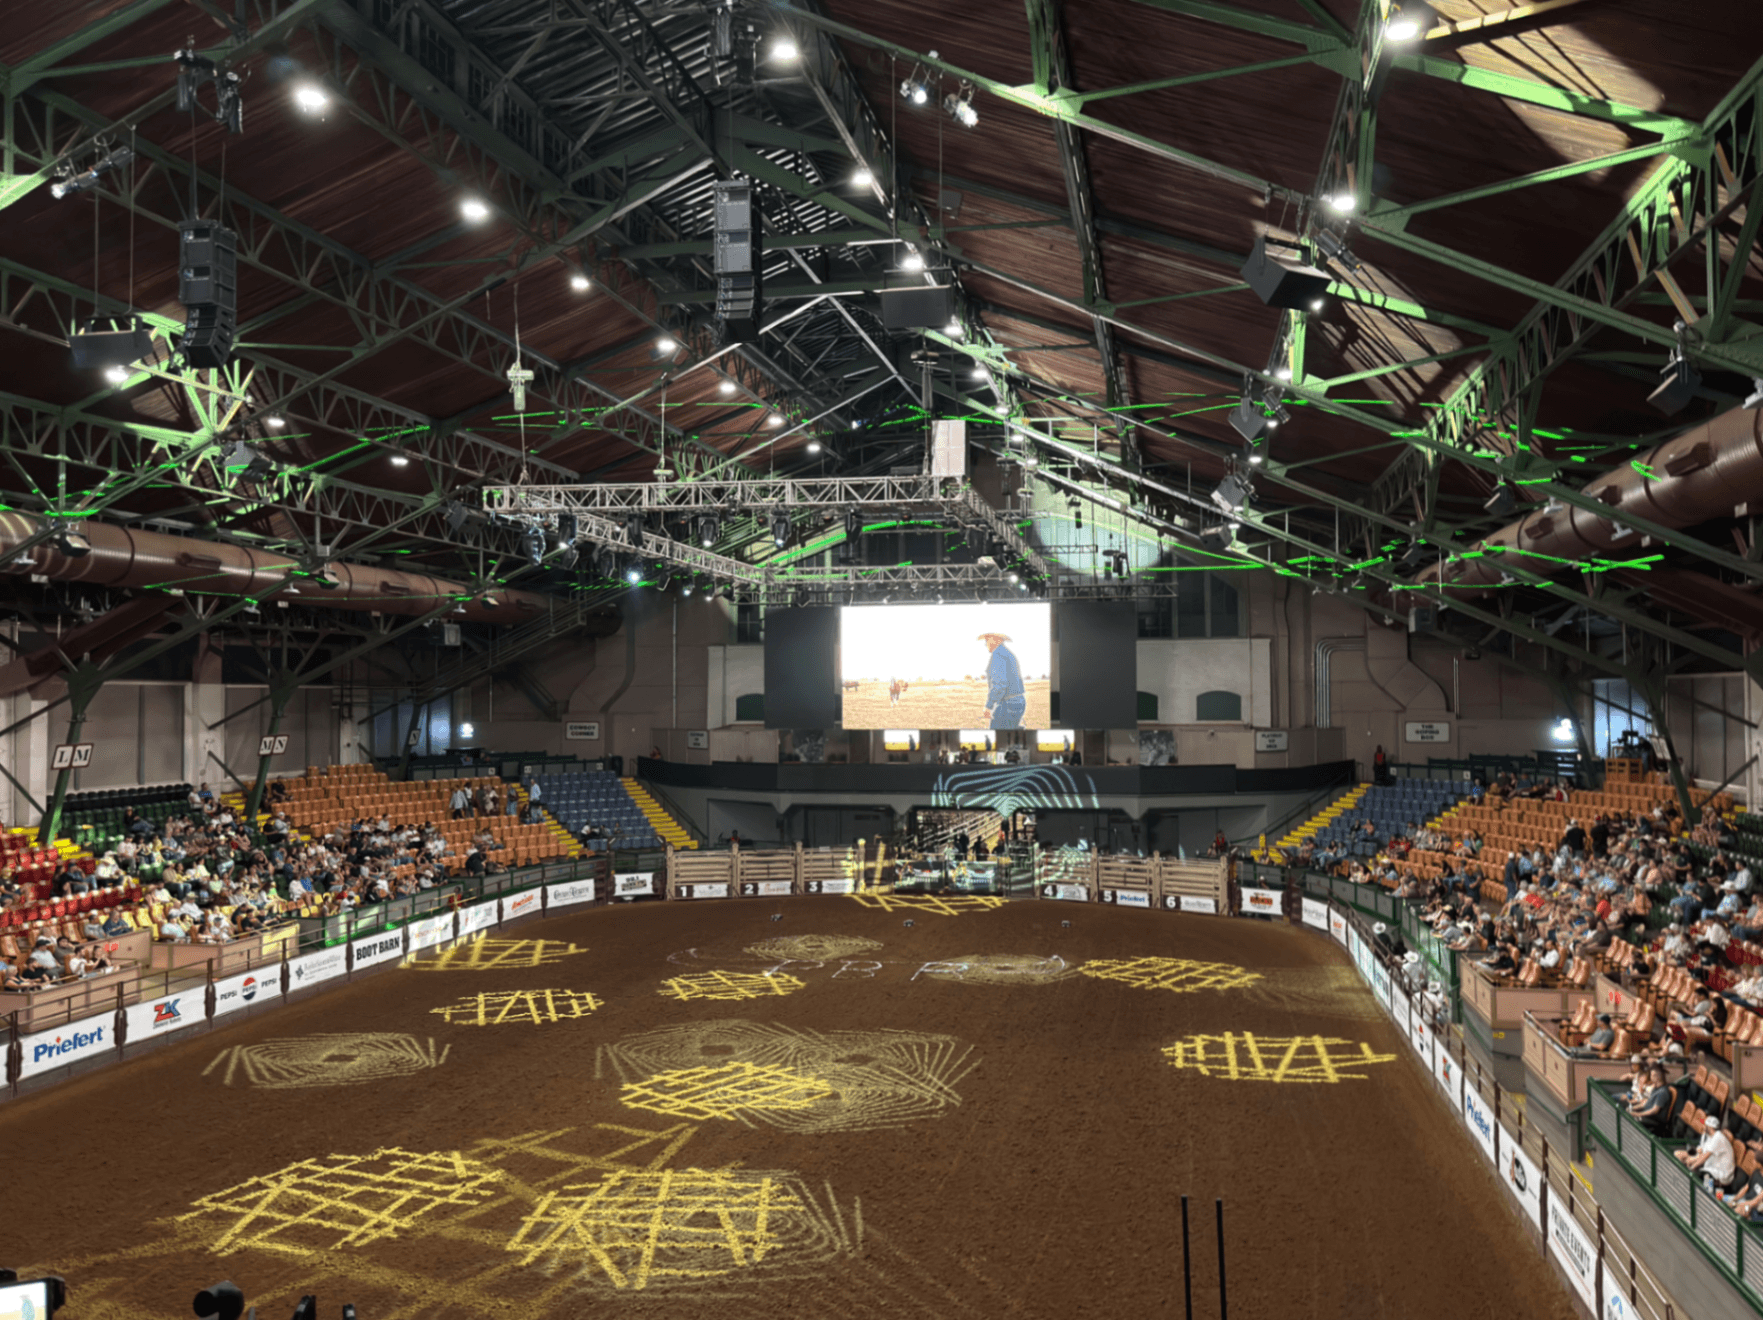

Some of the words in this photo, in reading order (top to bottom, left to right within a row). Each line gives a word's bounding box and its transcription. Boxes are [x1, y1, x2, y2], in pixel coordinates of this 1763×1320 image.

[274, 739, 287, 750] N
[58, 750, 69, 763] L
[73, 749, 90, 762] M
[681, 886, 688, 898] 1
[744, 883, 754, 895] 2
[809, 880, 818, 892] 3
[1043, 885, 1053, 896] 4
[1103, 890, 1113, 903] 5
[1166, 896, 1176, 909] 6
[356, 943, 378, 961] BOOT
[378, 936, 400, 954] BARN
[261, 977, 278, 988] PEPSI
[219, 990, 238, 1001] PEPSI
[33, 1026, 104, 1063] Priefert
[1466, 1094, 1491, 1143] Priefert
